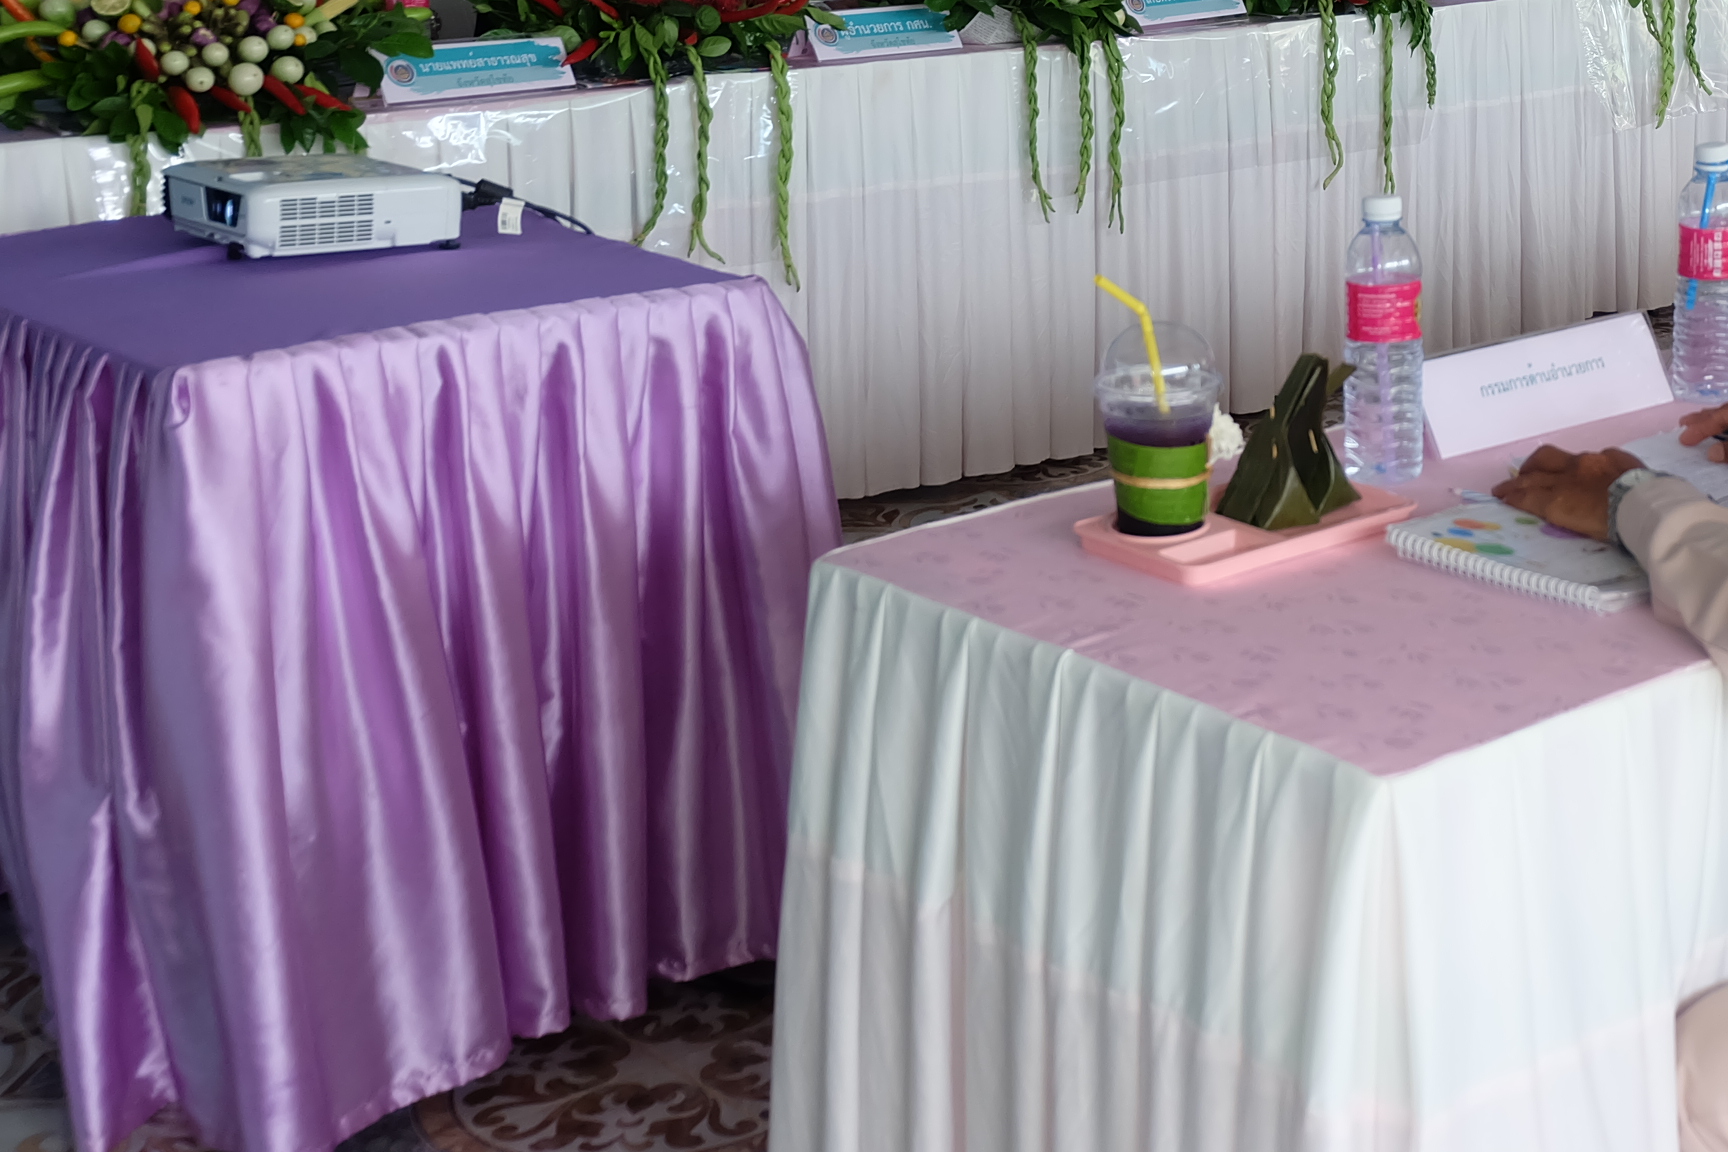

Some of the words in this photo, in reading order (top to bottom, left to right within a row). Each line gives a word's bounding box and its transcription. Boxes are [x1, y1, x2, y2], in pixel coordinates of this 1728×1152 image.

[418, 51, 537, 74] นายแพทย์สาธารณสุข
